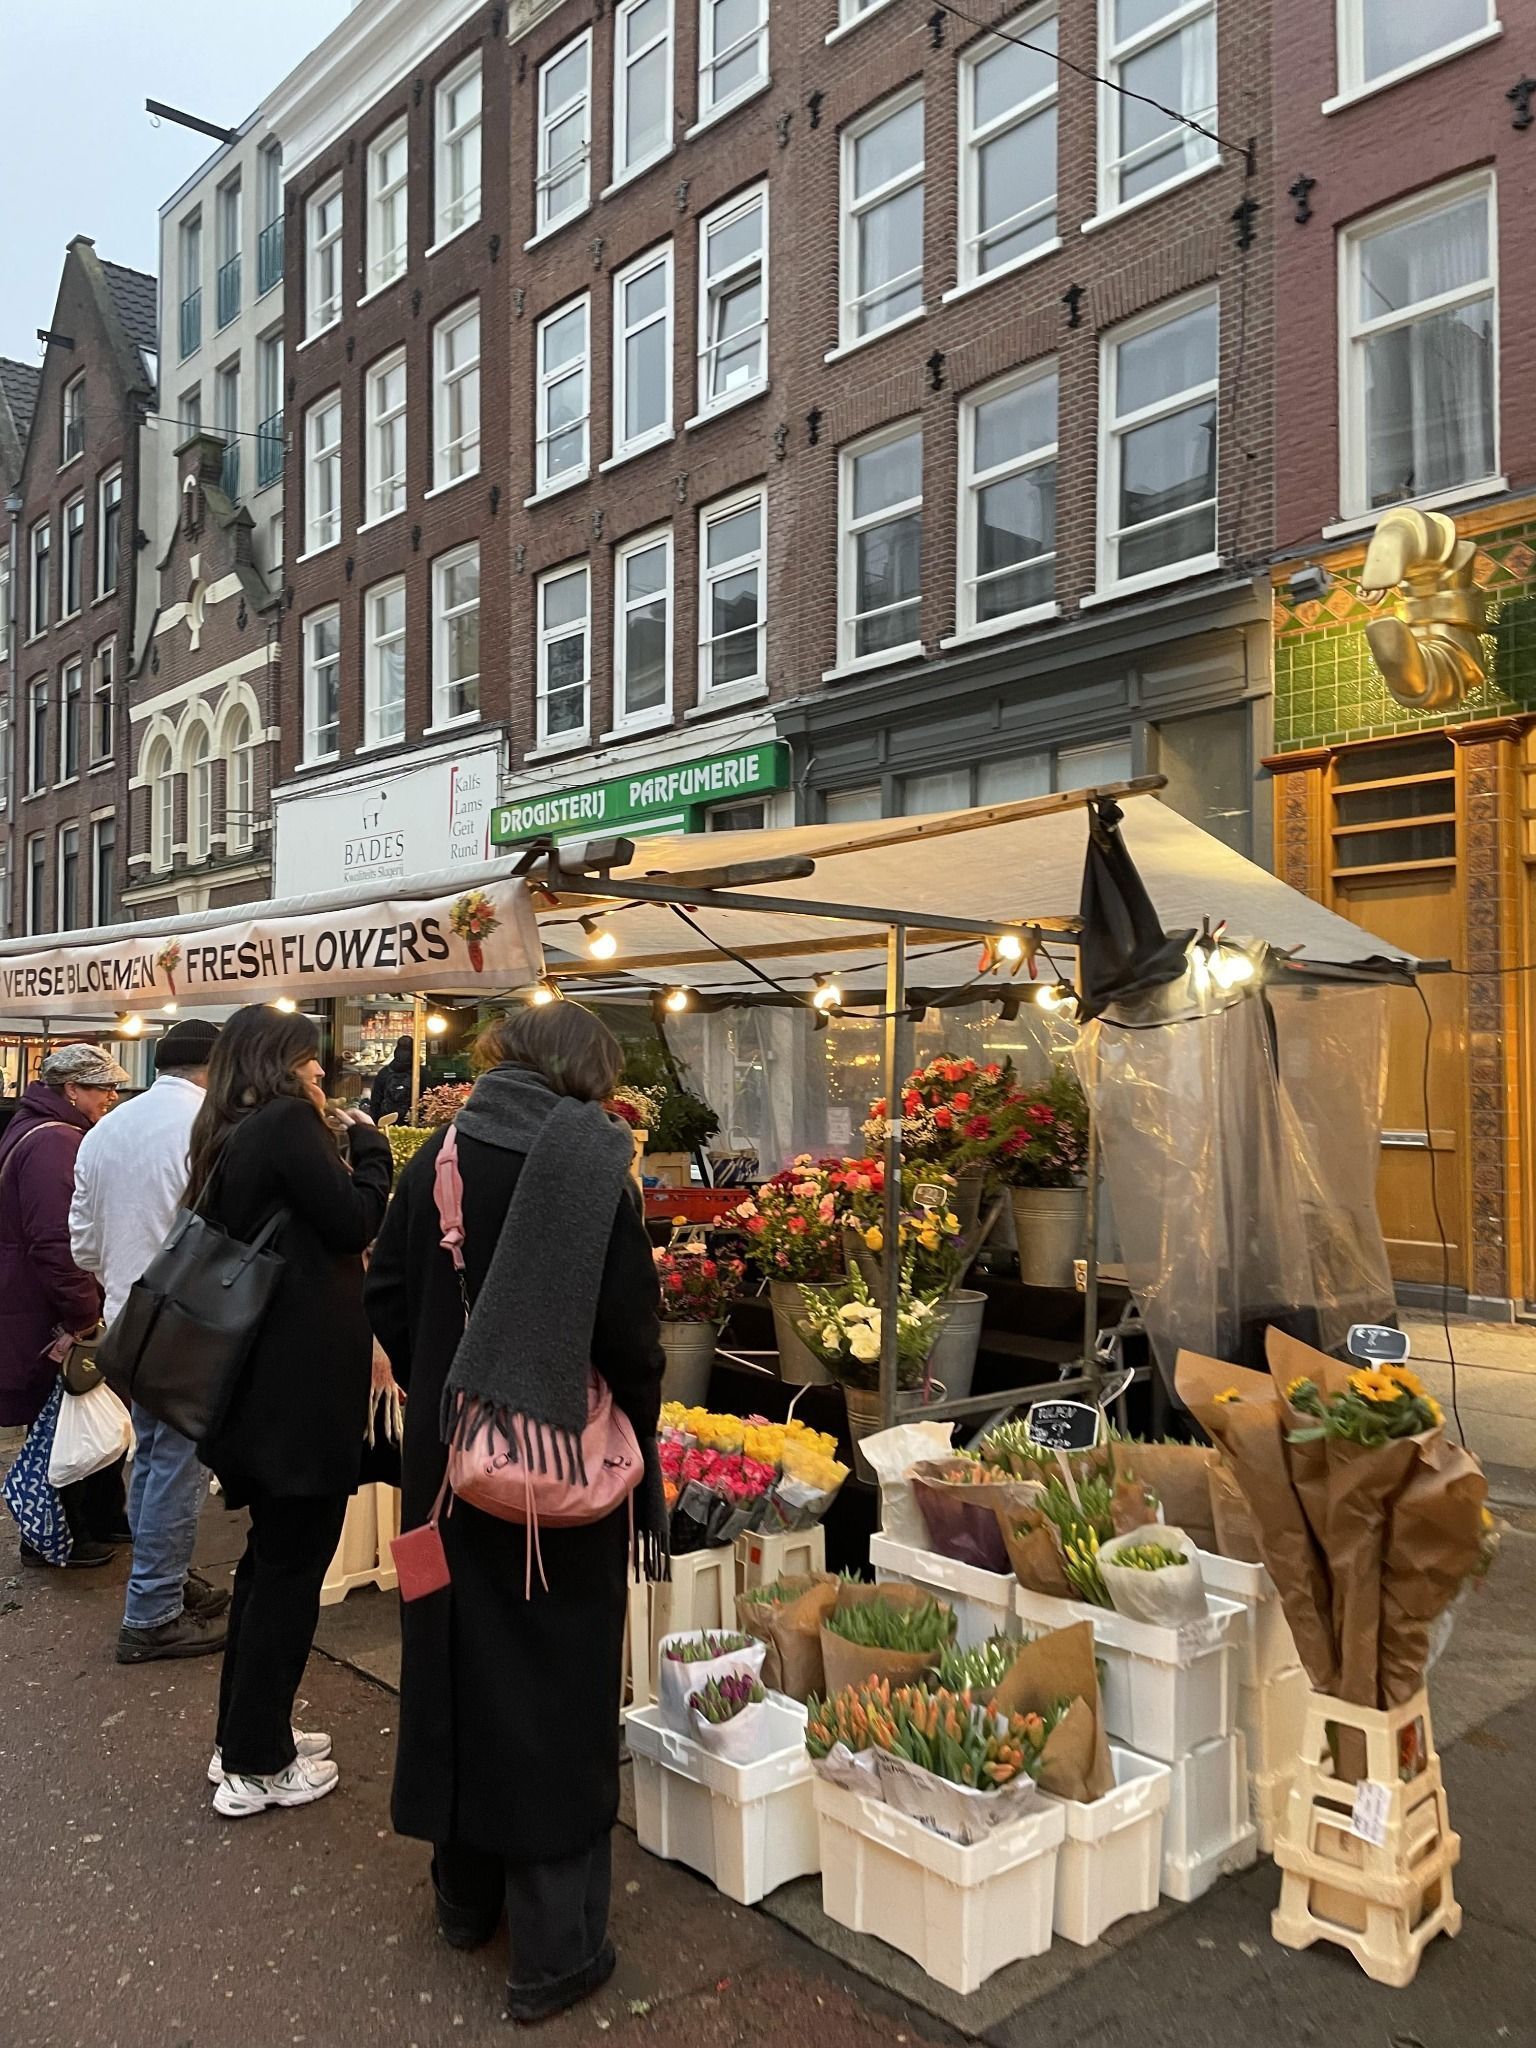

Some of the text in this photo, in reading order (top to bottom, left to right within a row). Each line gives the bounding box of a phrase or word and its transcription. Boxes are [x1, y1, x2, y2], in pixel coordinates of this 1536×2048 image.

[455, 774, 481, 794] Kalfs
[500, 754, 760, 834] DROGISTERIJ PARFUMERIE
[455, 799, 483, 815] Lams
[452, 820, 475, 837] Geit
[344, 834, 404, 865] BADES
[451, 840, 479, 860] Rund
[3, 918, 450, 998] VERSE BLOEMEN FRESH FLOWERS
